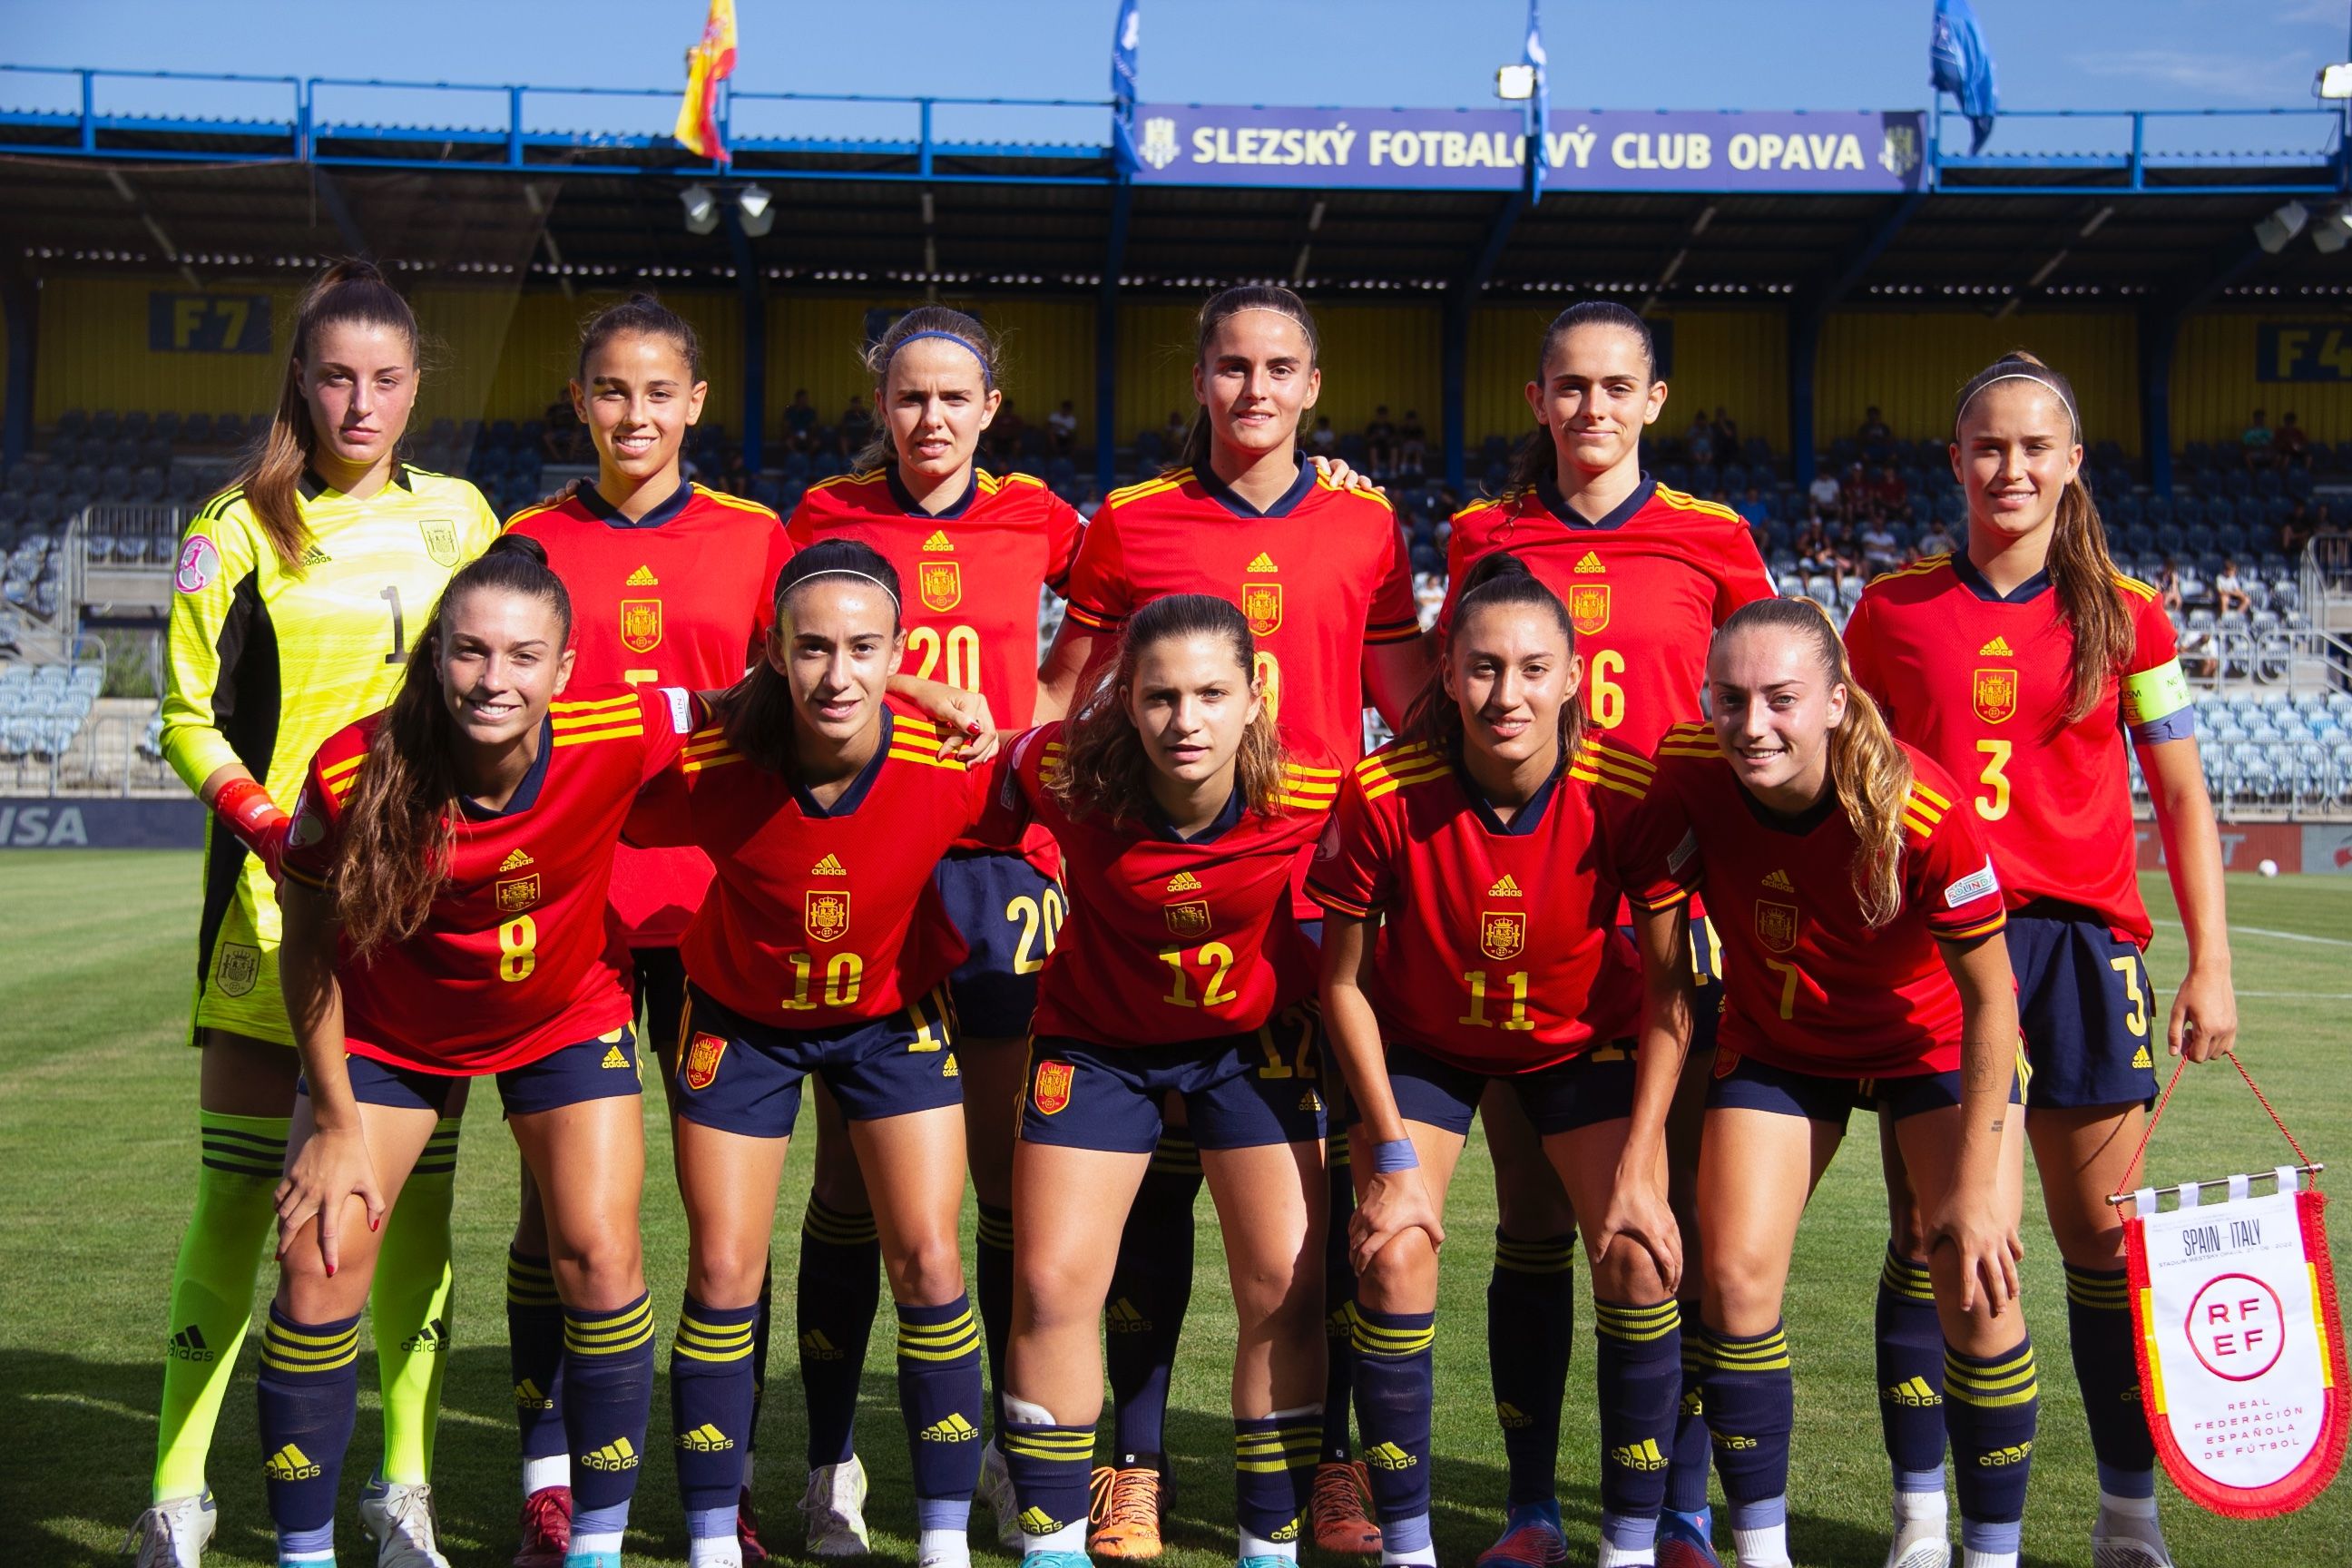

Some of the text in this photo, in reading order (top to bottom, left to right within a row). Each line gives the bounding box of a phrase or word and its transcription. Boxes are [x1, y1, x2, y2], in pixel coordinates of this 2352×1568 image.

[1191, 121, 1357, 171] SLEZSKÝ
[1610, 132, 1712, 171] CLUB
[1728, 132, 1866, 172] OPAVA
[922, 543, 955, 552] adidas
[304, 554, 333, 566] didas
[1247, 565, 1279, 573] adidas
[1573, 564, 1607, 574] adidas
[626, 577, 659, 586] adidas
[379, 585, 413, 664] 1
[907, 624, 981, 696] 20
[1979, 648, 2014, 657] adidas
[1590, 649, 1625, 730] 6
[1975, 740, 2013, 821] 3
[498, 857, 534, 873] adidas
[811, 867, 848, 876] adidas
[1166, 881, 1203, 893] adidas
[1487, 888, 1524, 897] adidas
[1004, 888, 1064, 975] 20
[499, 915, 537, 983] 8
[782, 952, 865, 1011] 10
[1159, 941, 1238, 1008] 12
[1457, 971, 1535, 1031] 11
[1765, 958, 1798, 1021] 7
[2110, 956, 2147, 1038] 3
[2182, 1224, 2221, 1257] SPAIN
[2230, 1218, 2261, 1250] ITALY
[2228, 1398, 2270, 1412] REAL
[2194, 1406, 2304, 1431] FEDERACIÓN
[920, 1427, 979, 1444] adidas
[2206, 1424, 2296, 1446] ESPAÑOLA
[1611, 1449, 1670, 1472] adidas
[2204, 1437, 2300, 1461] DE FÚTBOL
[582, 1454, 640, 1472] adidas
